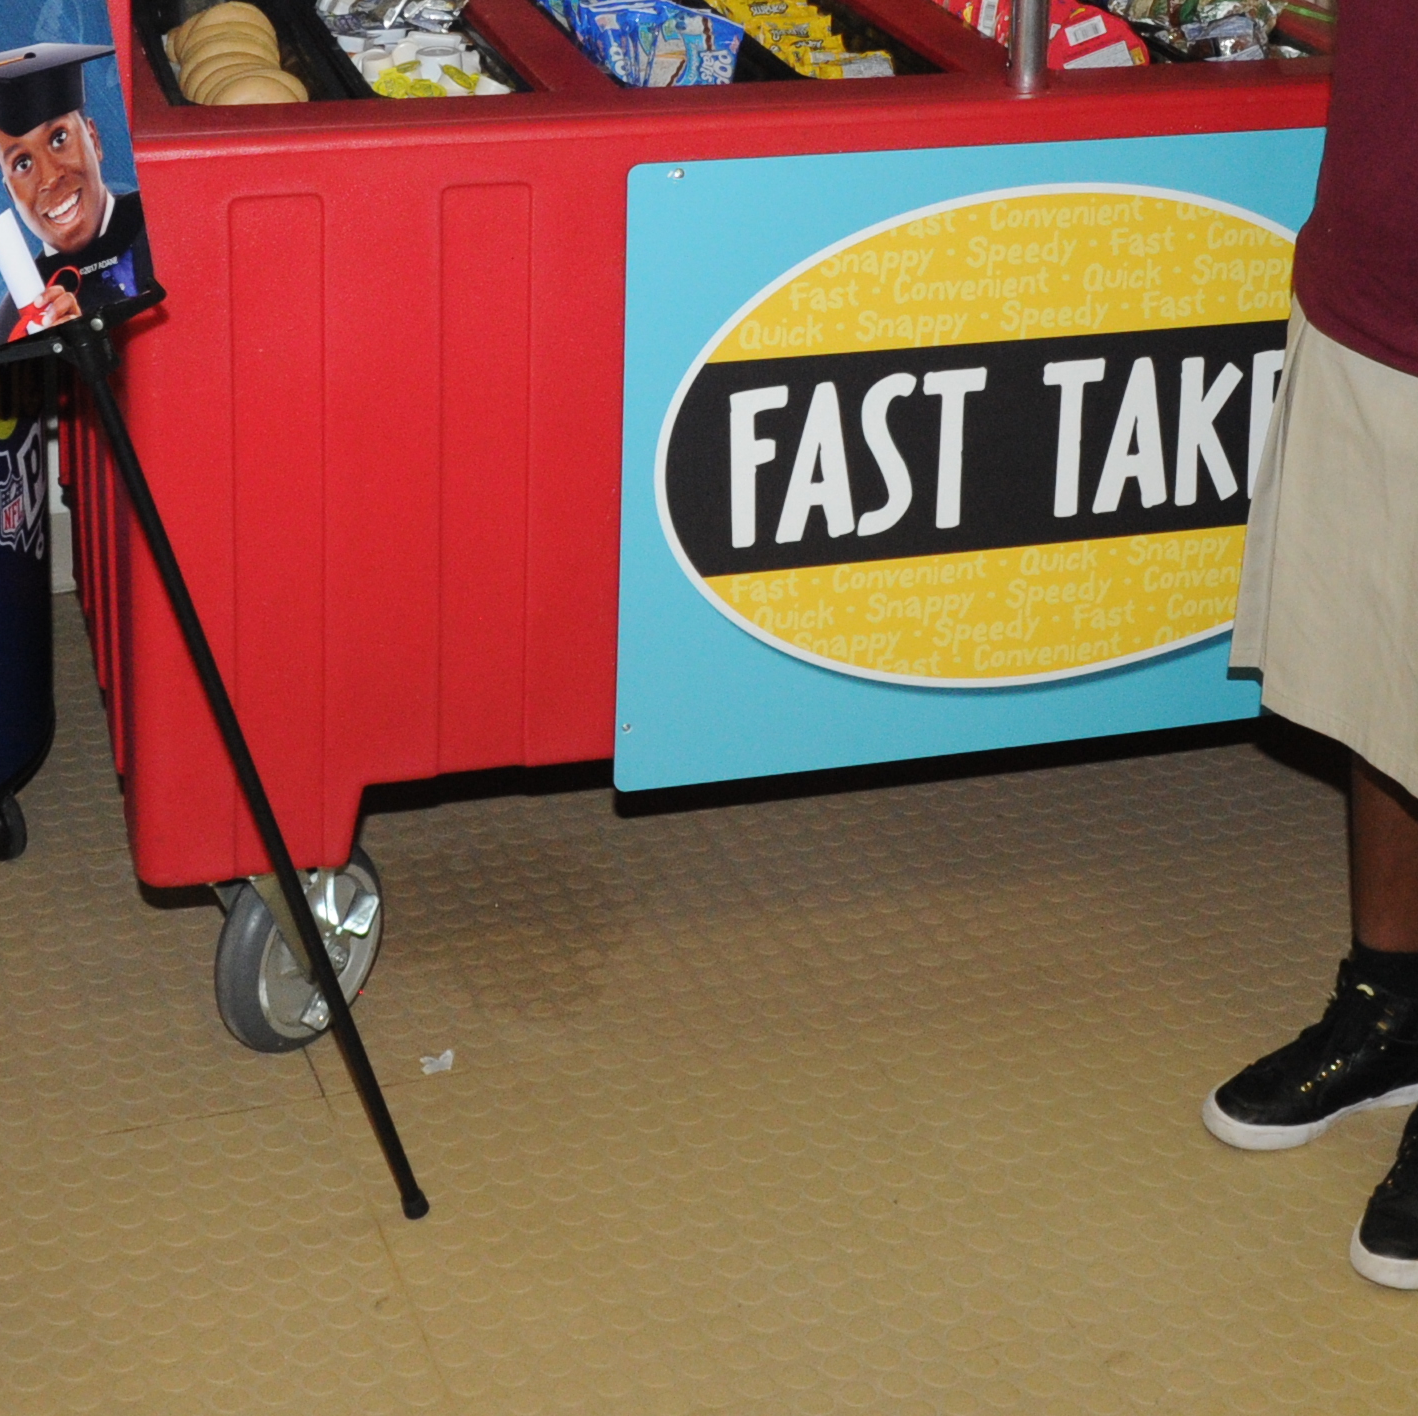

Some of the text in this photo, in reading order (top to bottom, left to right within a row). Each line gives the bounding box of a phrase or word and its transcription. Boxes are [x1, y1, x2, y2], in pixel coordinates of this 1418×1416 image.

[990, 195, 1144, 231] Convenient
[789, 254, 1292, 312] Fast Convenient Quick Snappy
[820, 248, 933, 283] Snappy
[966, 230, 1076, 276] Speedy
[1109, 226, 1175, 257] Fast
[739, 315, 824, 350] Quick
[856, 310, 968, 346] Snappy
[1001, 295, 1109, 339] Speedy
[1142, 289, 1205, 320] Fast
[729, 366, 988, 549] FAST
[731, 535, 1231, 603] Fast Convenient Quick Snappy
[865, 591, 974, 626] Snappy
[1005, 571, 1112, 616] Speedy
[933, 611, 1040, 654] Speedy
[1072, 600, 1135, 630] Fast
[974, 633, 1121, 671] Convenient
